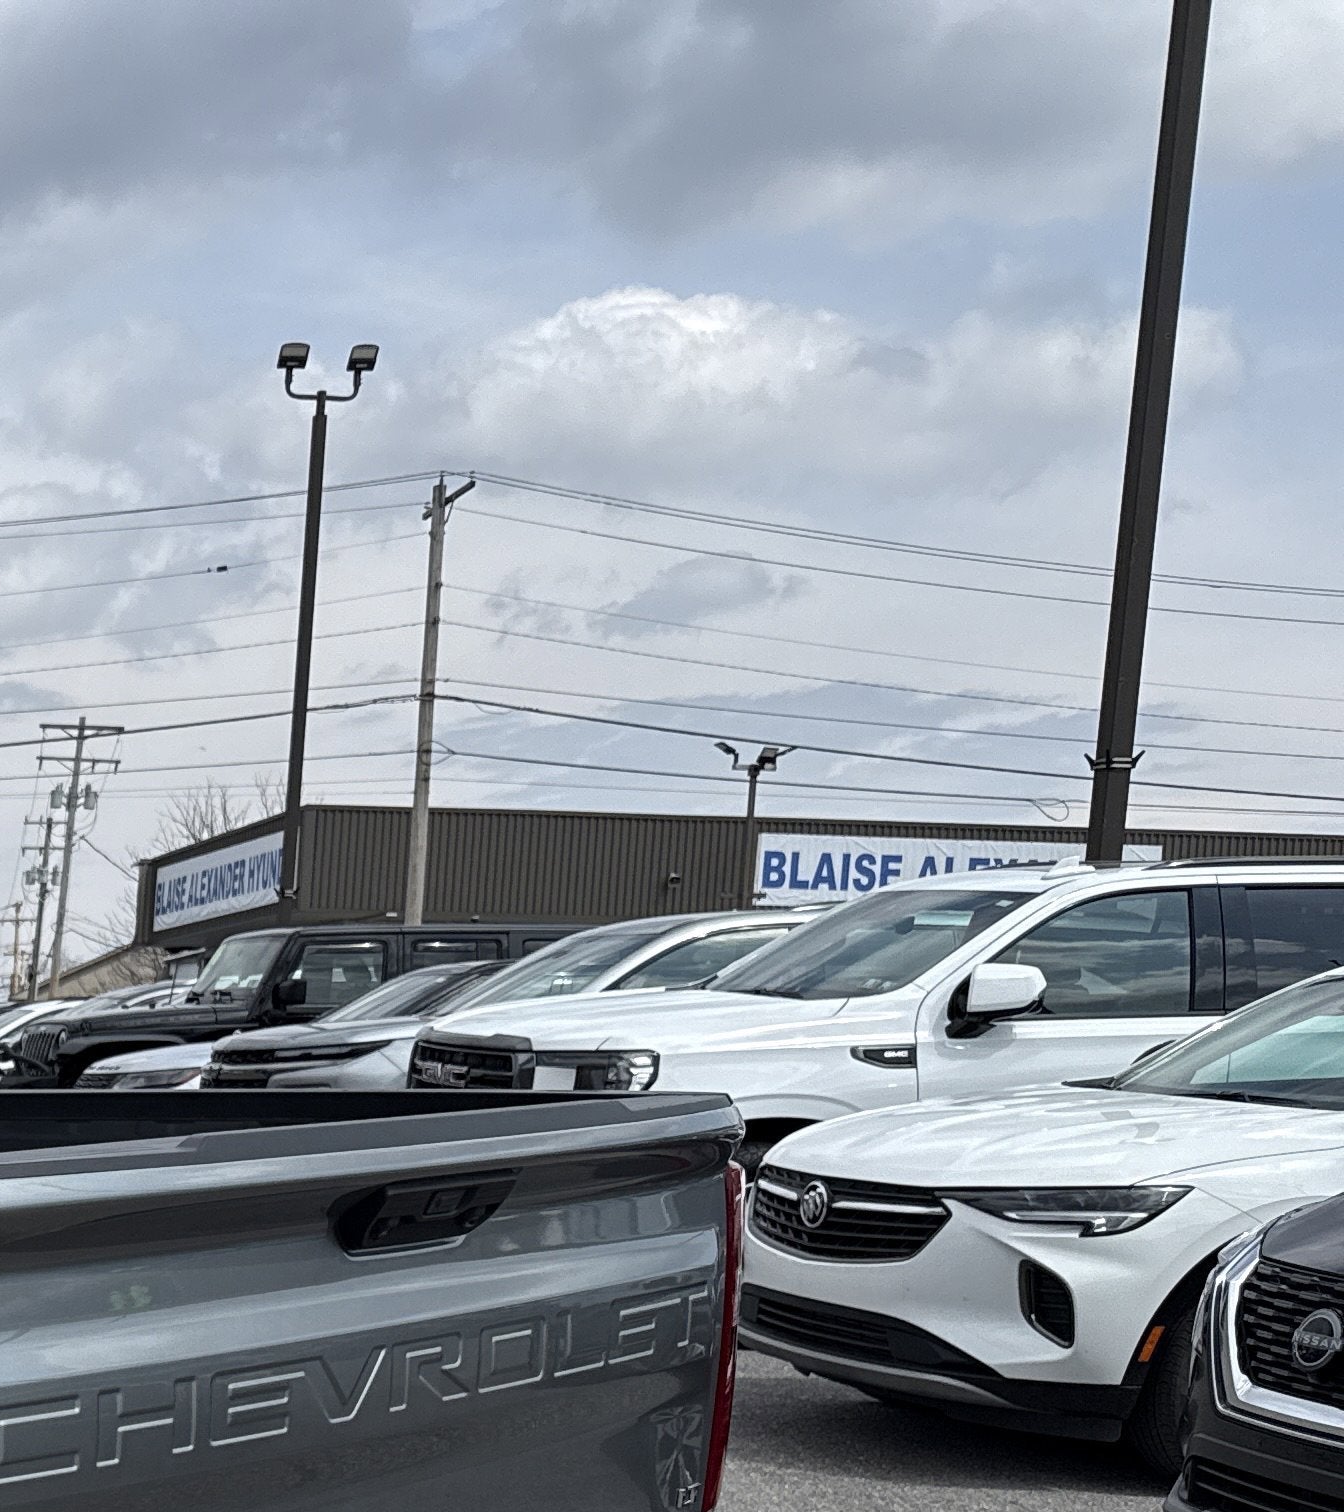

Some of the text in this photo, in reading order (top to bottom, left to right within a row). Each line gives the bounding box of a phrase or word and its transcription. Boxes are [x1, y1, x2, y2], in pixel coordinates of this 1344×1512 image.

[762, 850, 903, 892] BLAISE
[155, 875, 187, 916] BLAISE
[186, 859, 245, 909] ALEXANDER
[883, 1050, 909, 1058] GMC
[1293, 1329, 1343, 1350] NISSAN
[676, 1482, 701, 1509] LT
